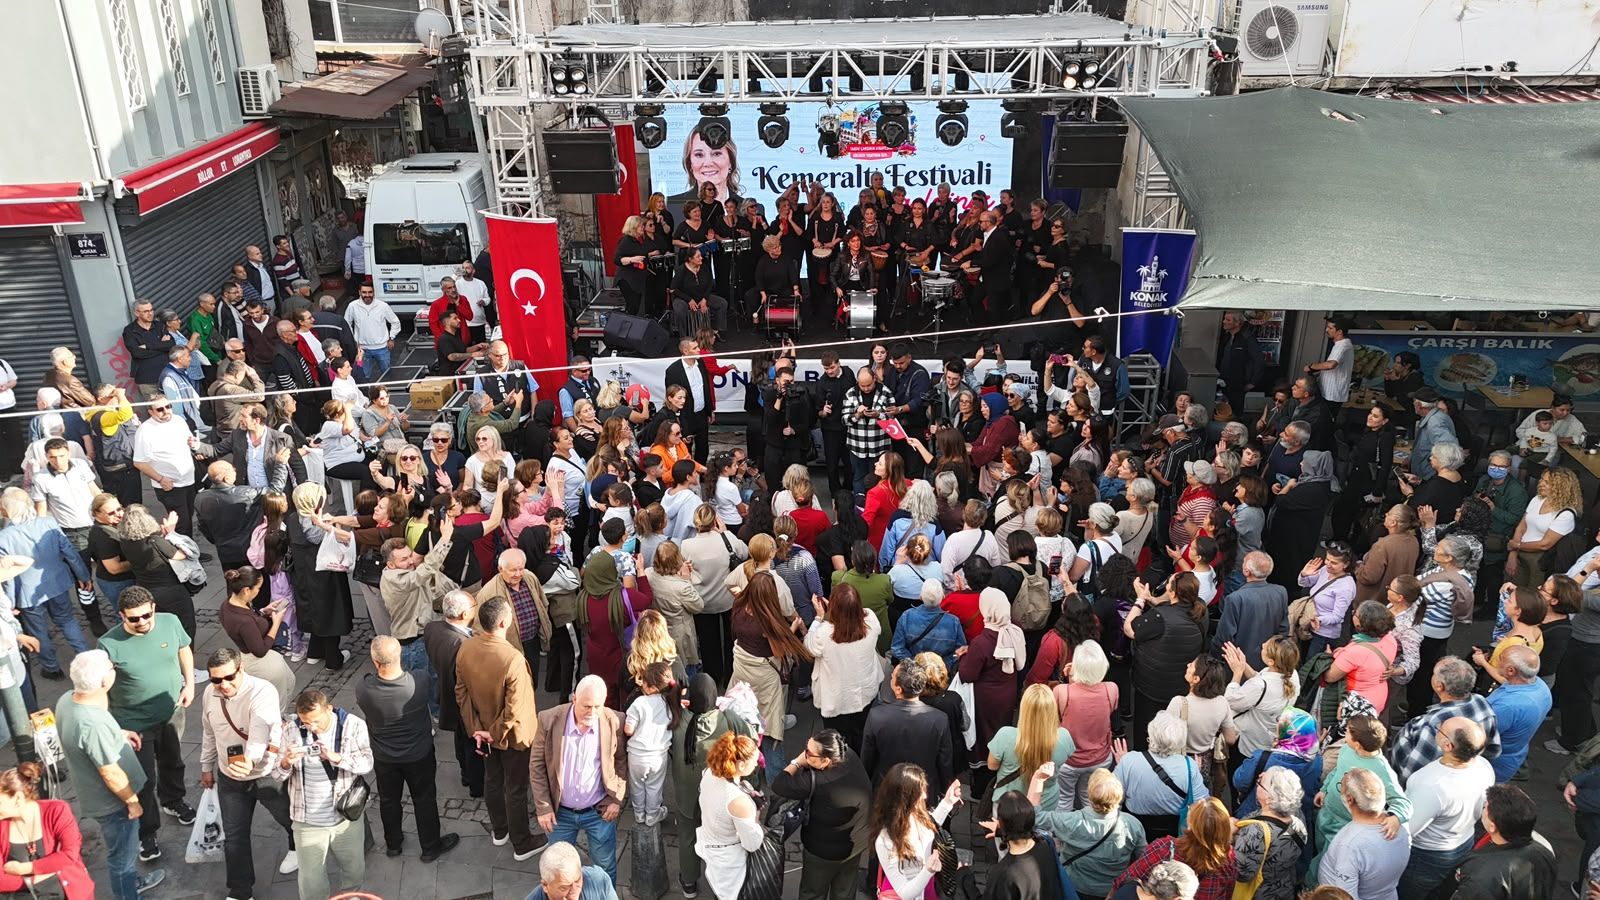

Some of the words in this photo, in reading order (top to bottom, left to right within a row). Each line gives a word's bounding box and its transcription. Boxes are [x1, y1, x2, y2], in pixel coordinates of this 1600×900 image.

[220, 160, 228, 172] ET
[752, 163, 878, 194] Kemeralt
[885, 161, 992, 188] Festivali
[1130, 291, 1168, 302] KONAK
[1407, 337, 1477, 350] ÇARŞI
[1483, 338, 1555, 349] BALIK
